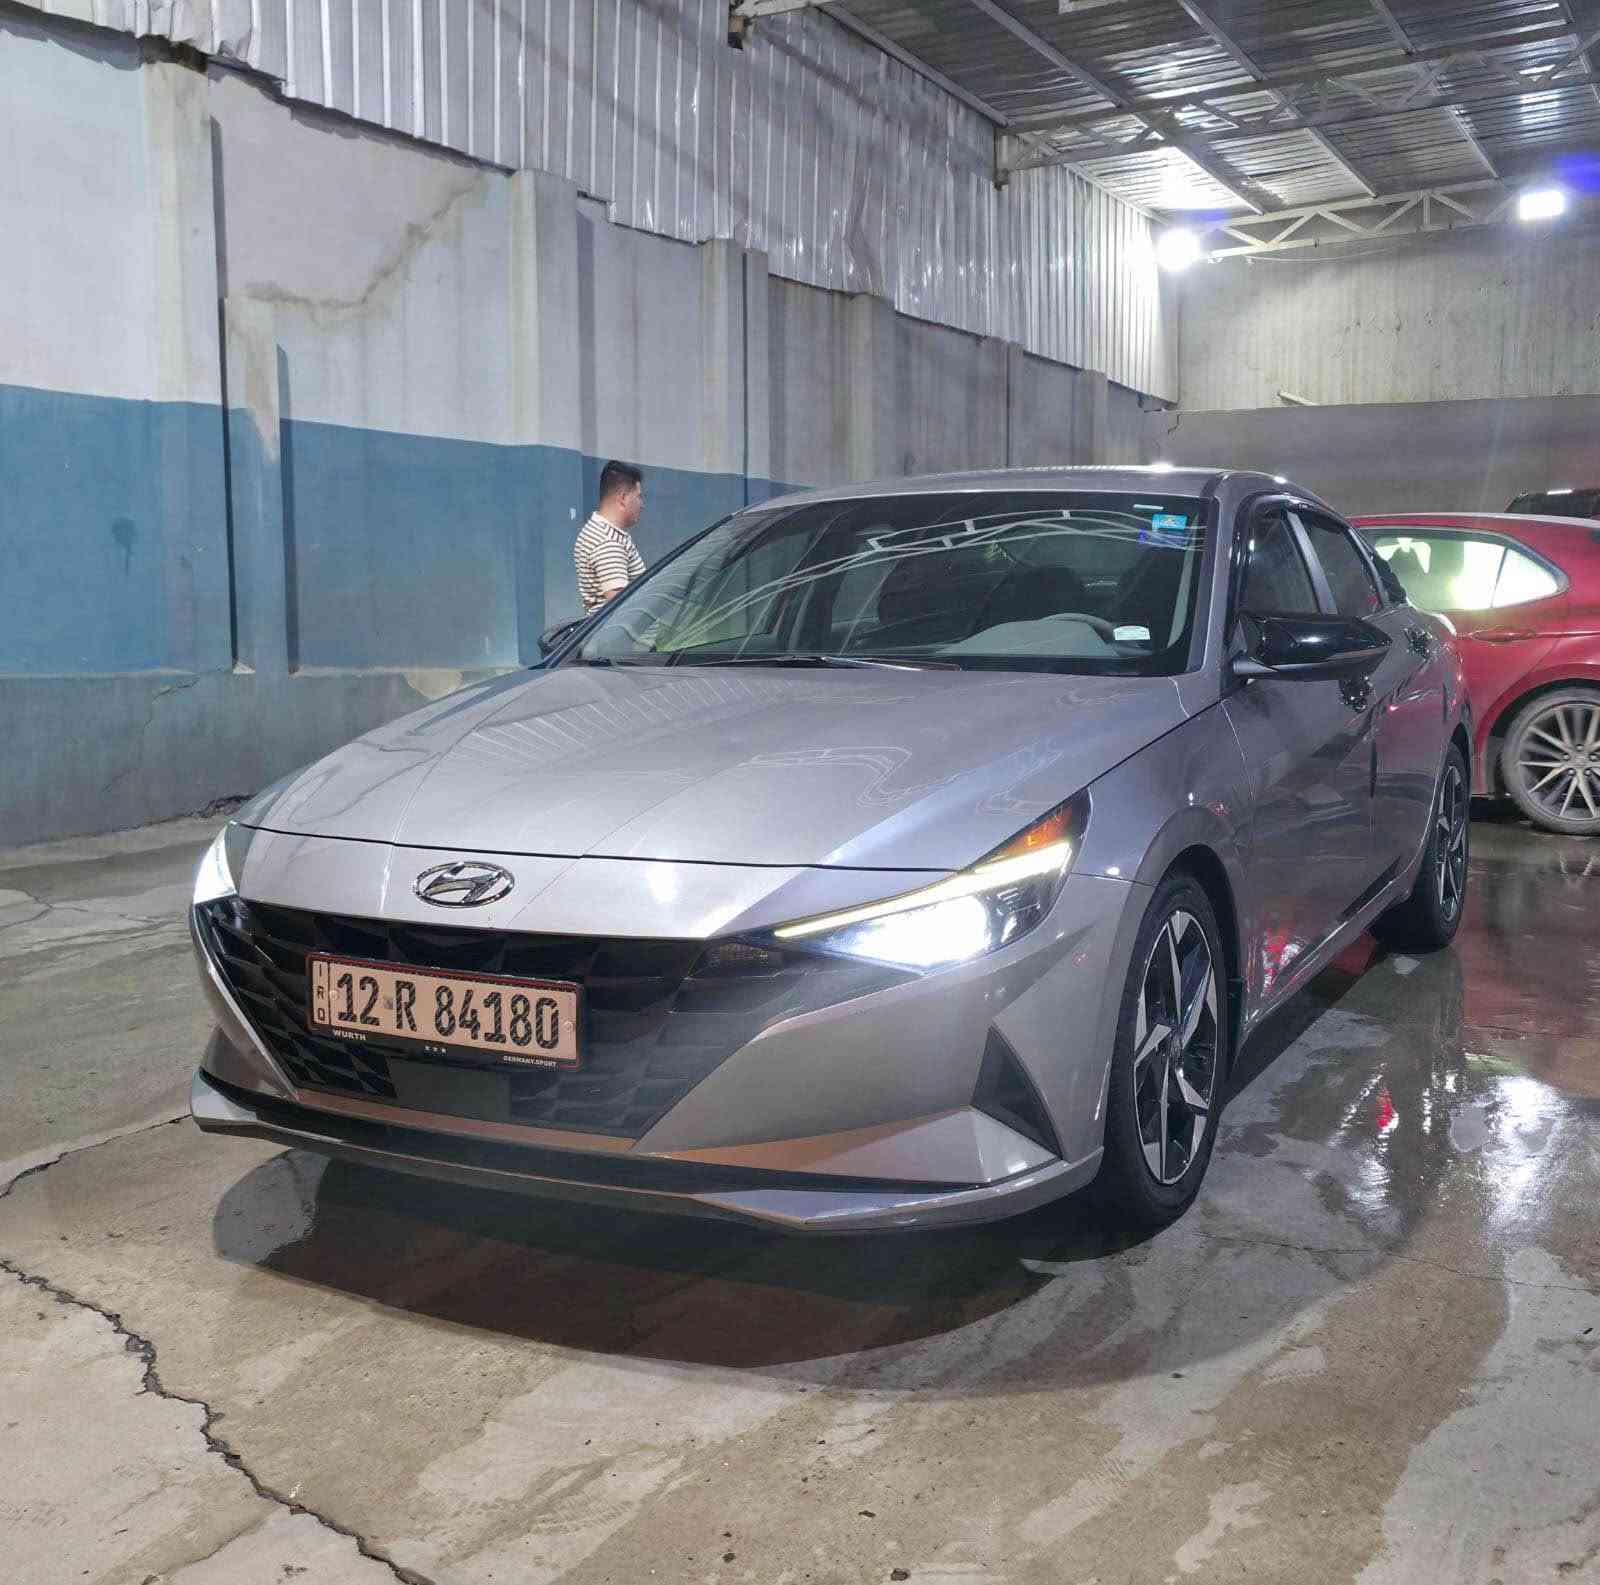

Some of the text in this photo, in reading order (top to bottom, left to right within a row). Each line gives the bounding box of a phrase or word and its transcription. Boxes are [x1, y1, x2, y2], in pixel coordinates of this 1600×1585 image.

[337, 973, 559, 1050] 12 R 84180
